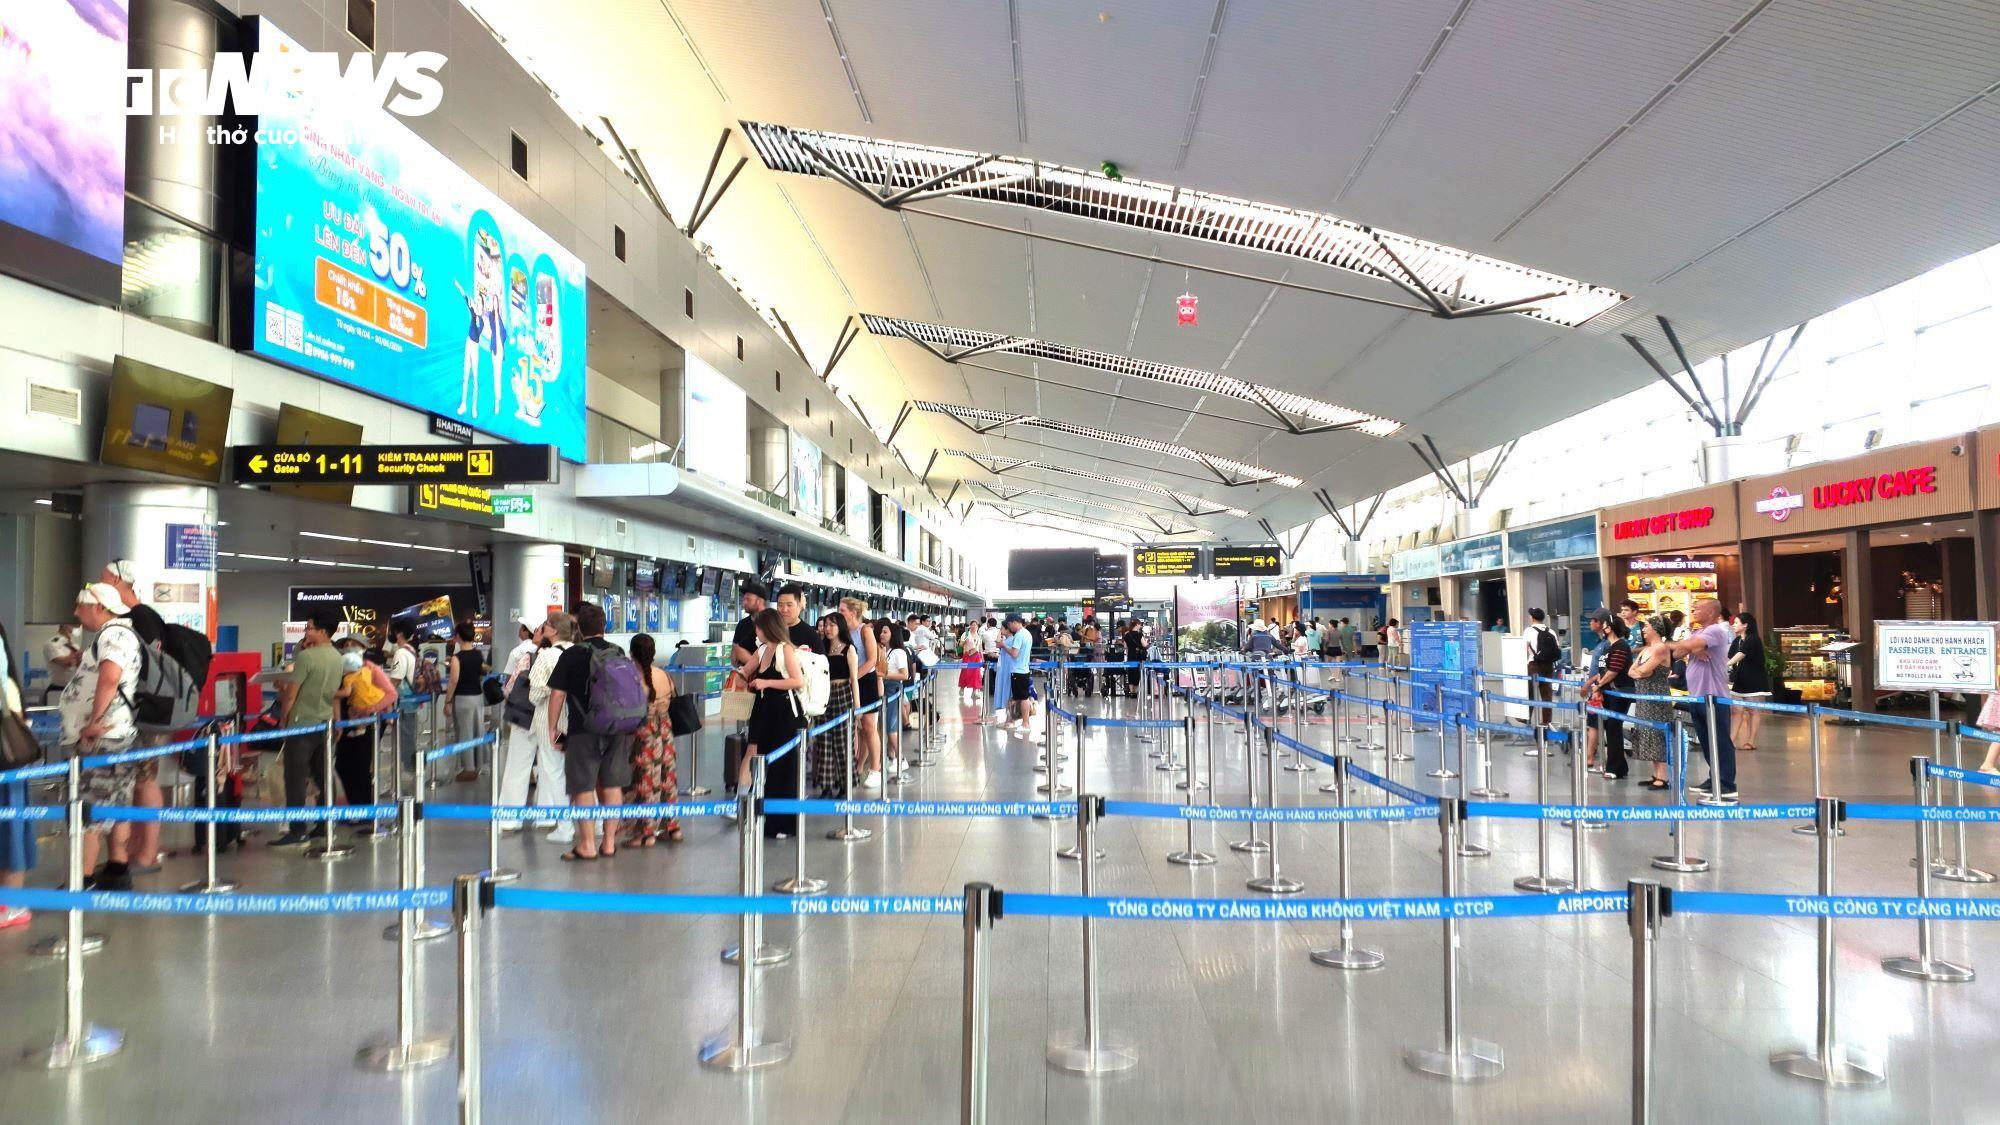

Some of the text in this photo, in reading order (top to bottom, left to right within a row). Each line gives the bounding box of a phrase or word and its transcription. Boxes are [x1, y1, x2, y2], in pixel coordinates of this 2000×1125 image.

[404, 453, 424, 462] TRA
[425, 453, 437, 462] AN
[440, 453, 463, 462] NINH
[378, 464, 445, 475] Security Check
[1813, 477, 1875, 510] LUCKY
[1878, 466, 1936, 499] CAFE
[1614, 506, 1714, 540] LUCKY GIFT SHOP
[297, 592, 343, 601] Sacombank
[342, 605, 376, 622] Visa
[1888, 647, 1987, 655] PASSENGER ENTRANCE
[1930, 767, 1964, 778] NAM CTCP
[550, 809, 561, 819] TY
[682, 806, 705, 816] NAM
[892, 804, 905, 814] TY
[1028, 804, 1050, 814] NAM
[1240, 808, 1251, 819] TY
[1381, 808, 1404, 818] NAM
[1574, 807, 1603, 819] CÔNG
[1606, 809, 1619, 819] TY
[1654, 807, 1685, 819] HÀNG
[1687, 807, 1724, 819] KHÔNG
[1727, 807, 1750, 820] VIỆT
[1753, 808, 1778, 818] NAM
[1787, 807, 1816, 818] CTCP
[1955, 807, 1986, 820] CÔNG
[175, 896, 193, 911] TY
[279, 893, 329, 912] KHÔNG
[332, 892, 362, 912] VIỆT
[365, 894, 398, 909] NAM
[873, 899, 889, 913] TY
[1833, 898, 1878, 915] CÔNG
[1882, 901, 1903, 915] TY
[1151, 902, 1193, 918] CÔNG
[1197, 904, 1215, 918] TY
[1219, 899, 1261, 918] CẢNG
[1265, 902, 1307, 918] HÀNG
[1312, 900, 1364, 918] KHÔNG
[1367, 901, 1401, 920] VIỆT
[1405, 903, 1440, 917] NAM
[1454, 901, 1494, 916] CTCP
